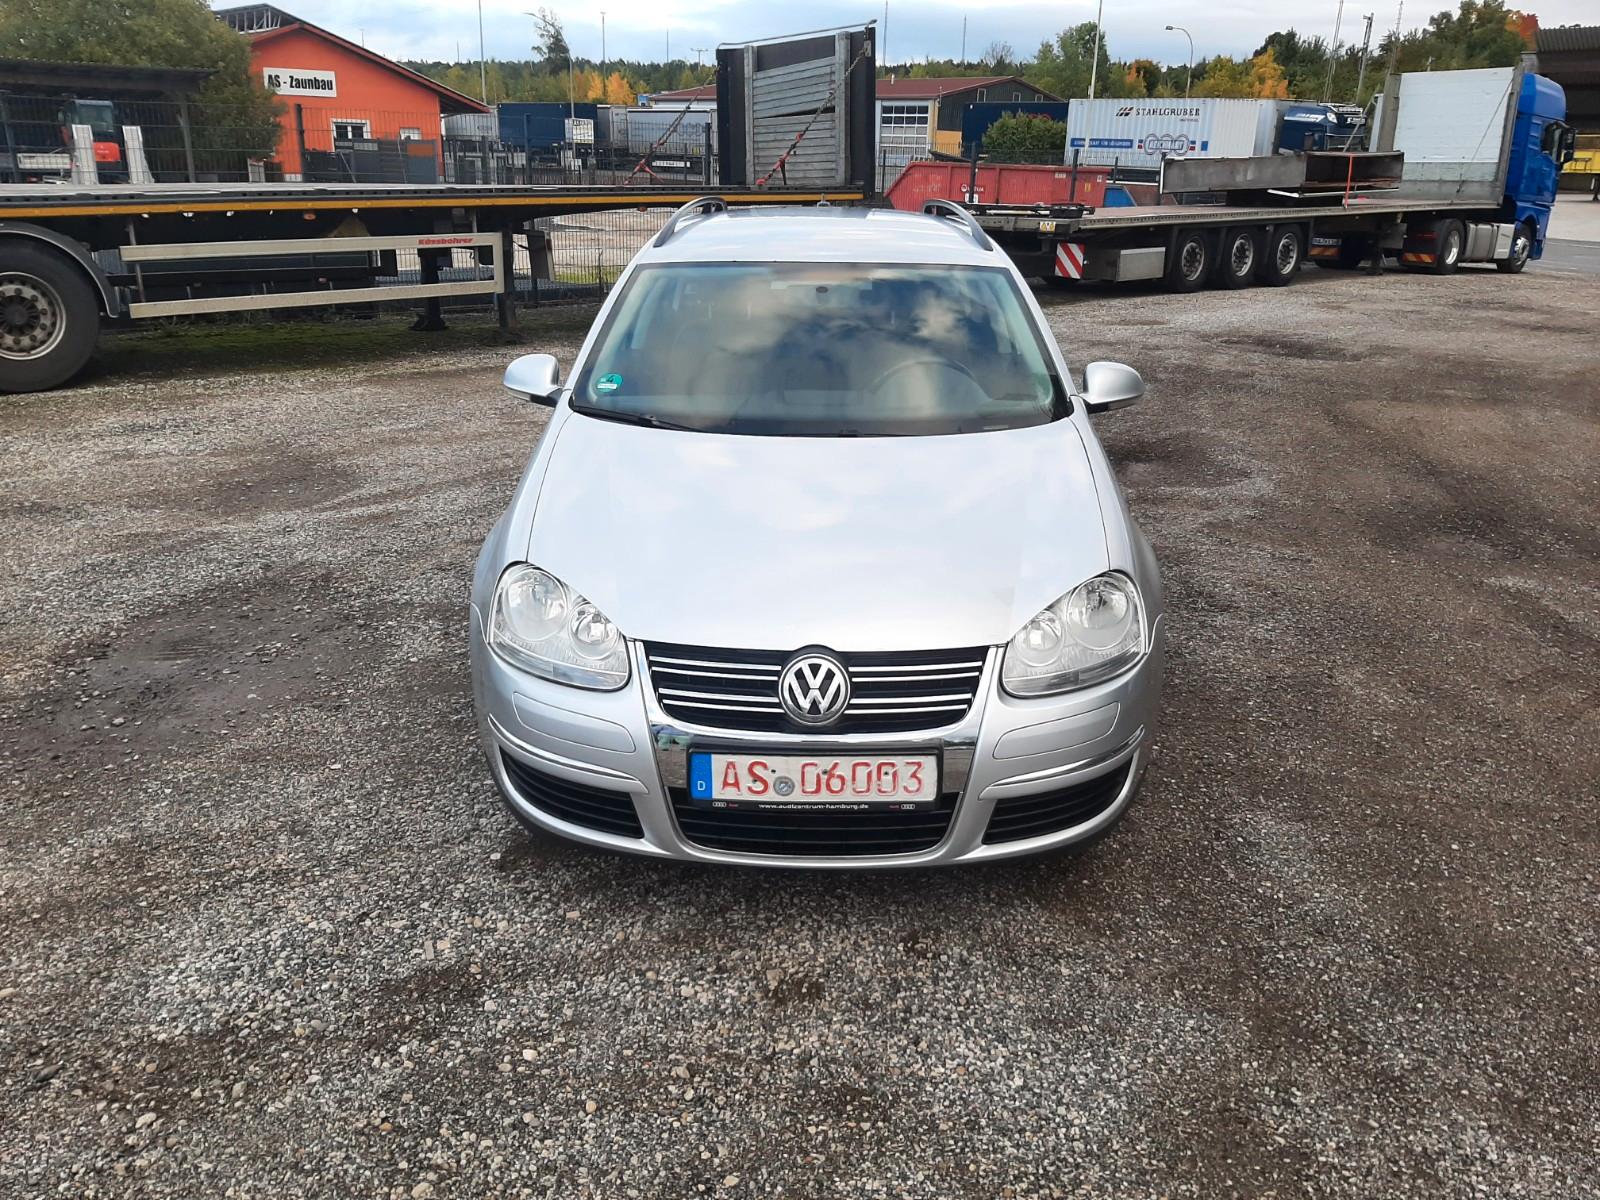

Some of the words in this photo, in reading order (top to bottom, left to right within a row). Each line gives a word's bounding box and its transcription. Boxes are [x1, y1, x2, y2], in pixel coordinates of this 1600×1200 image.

[267, 74, 281, 88] AS
[289, 75, 333, 91] Zaunbau
[1136, 107, 1200, 117] STAHLGRUBER
[721, 760, 769, 795] AS
[801, 761, 923, 795] 06003
[697, 780, 706, 791] D
